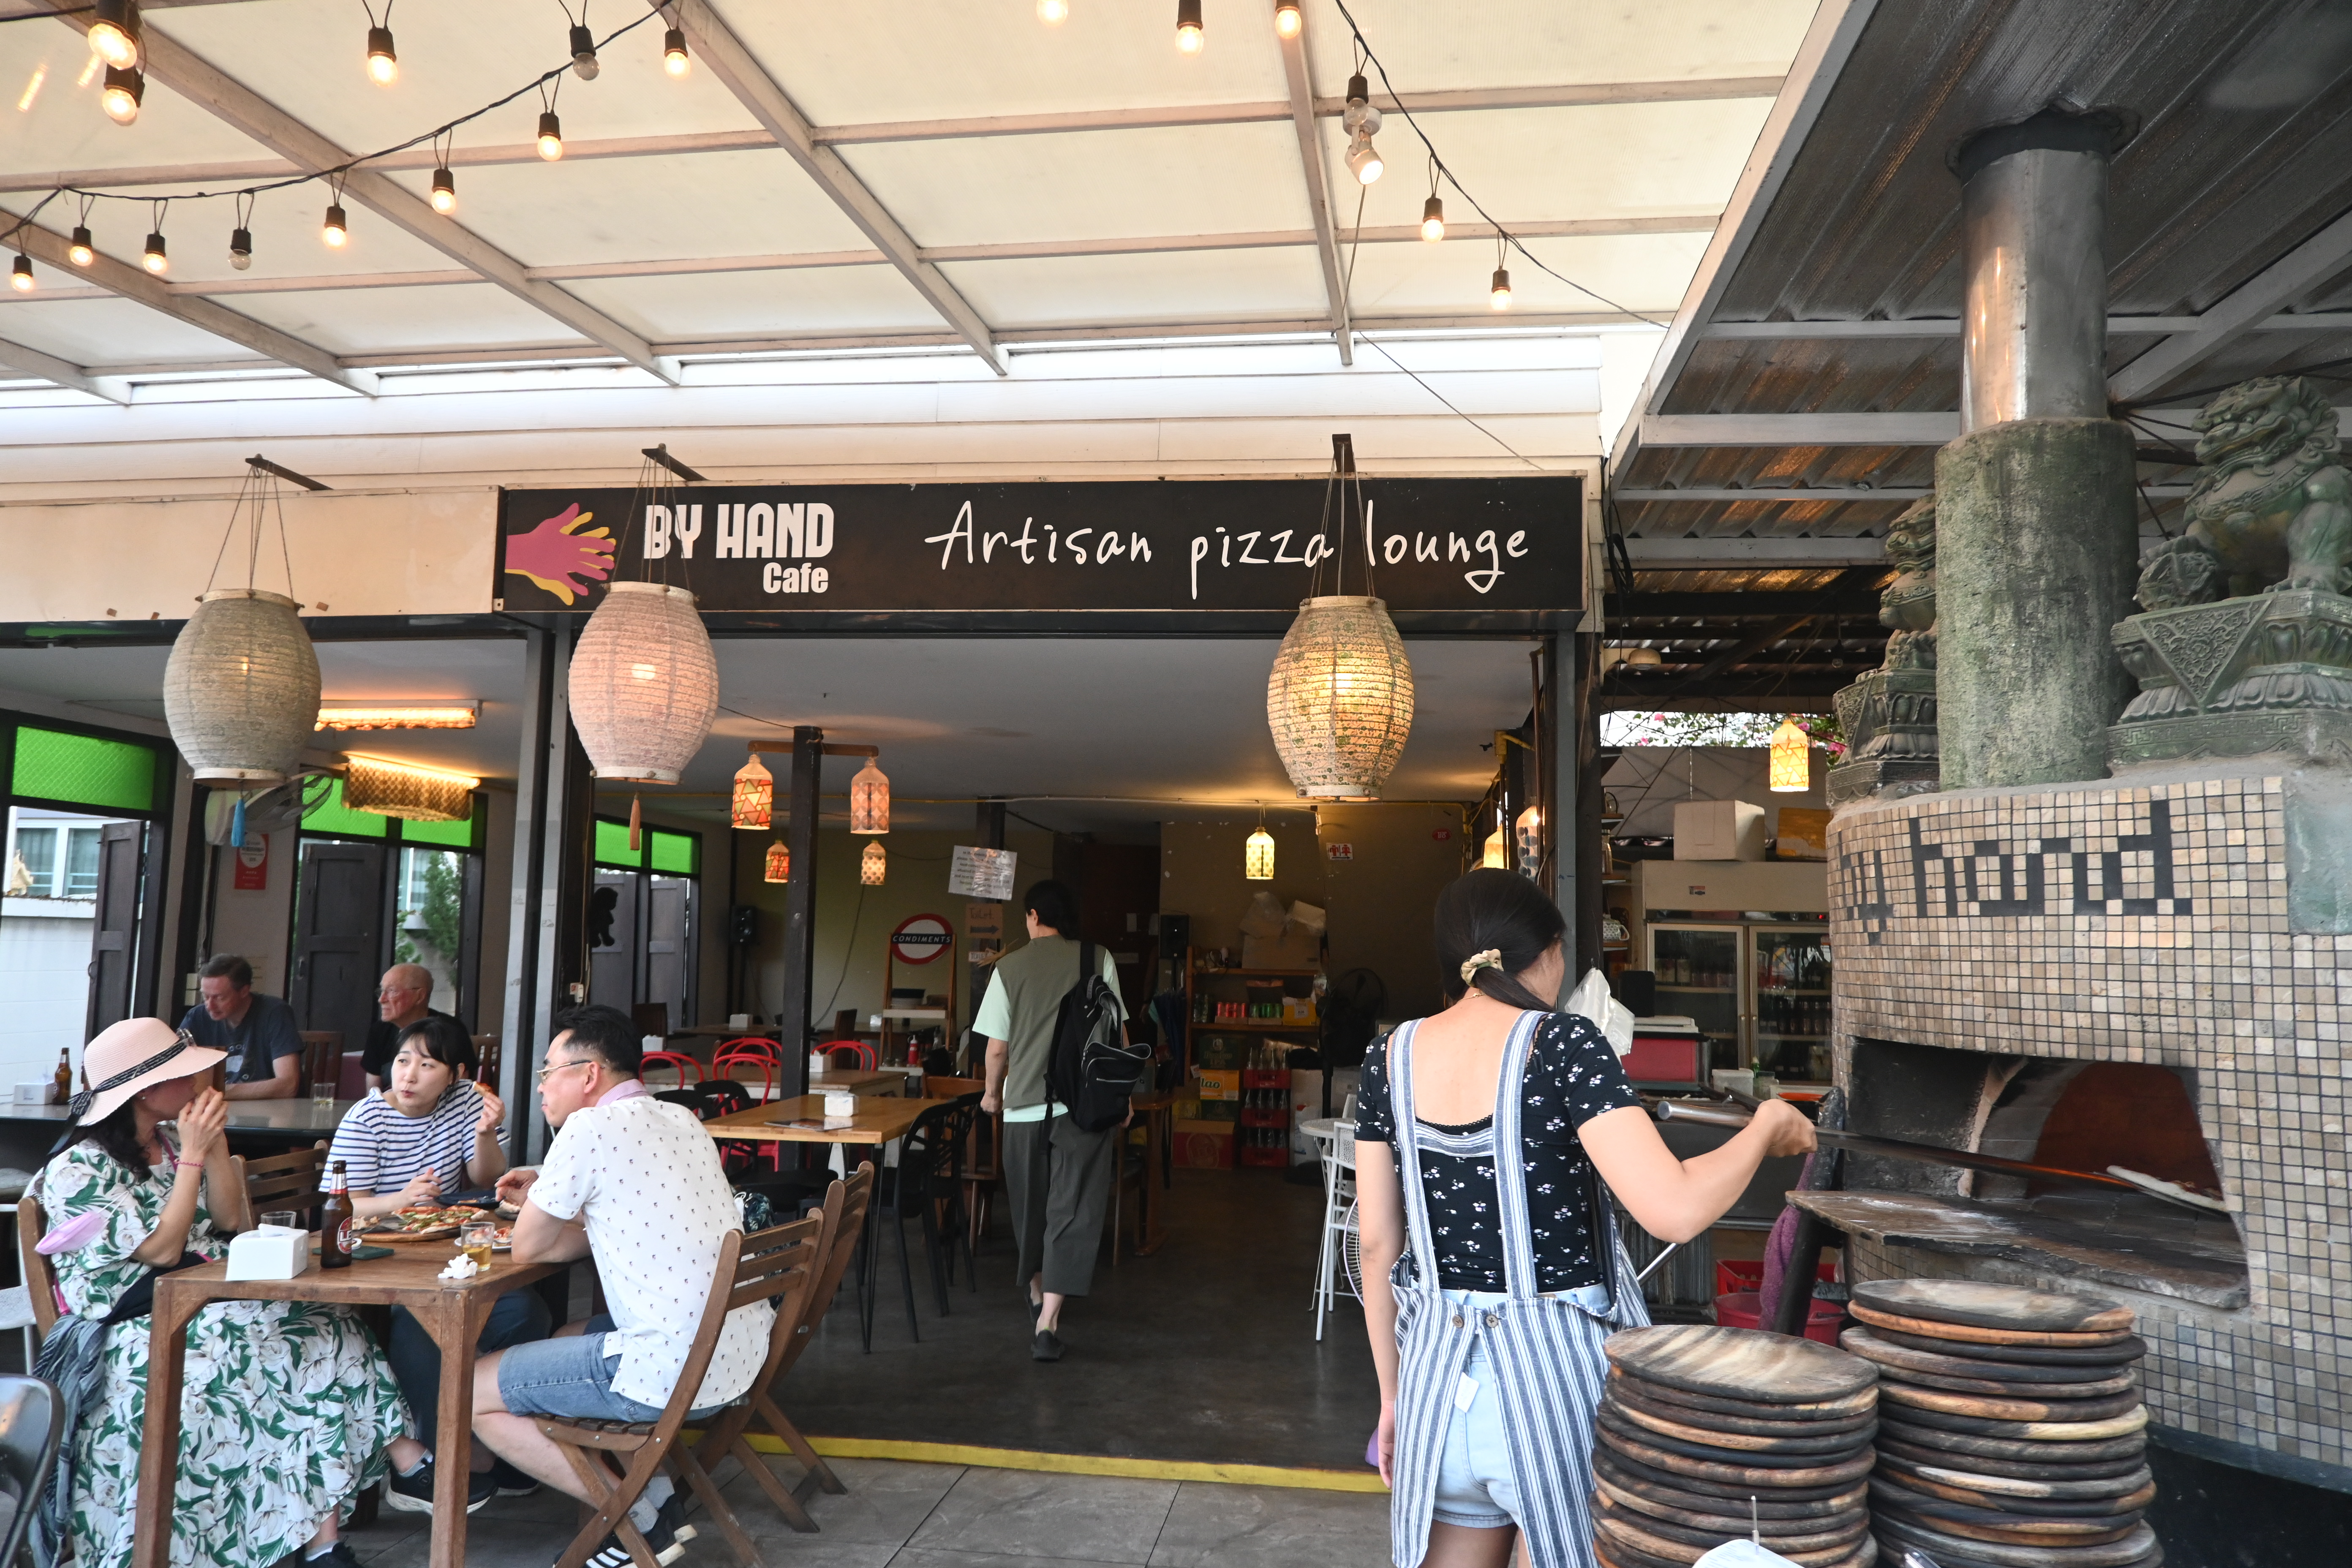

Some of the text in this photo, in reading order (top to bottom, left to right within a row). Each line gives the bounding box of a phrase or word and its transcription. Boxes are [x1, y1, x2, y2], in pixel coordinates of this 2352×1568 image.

[643, 503, 835, 559] BY HAND
[924, 499, 1529, 600] Artisan pizza lounge
[763, 562, 829, 593] Cafe
[1908, 799, 2192, 918] hand
[892, 935, 951, 943] CONDIMENTS
